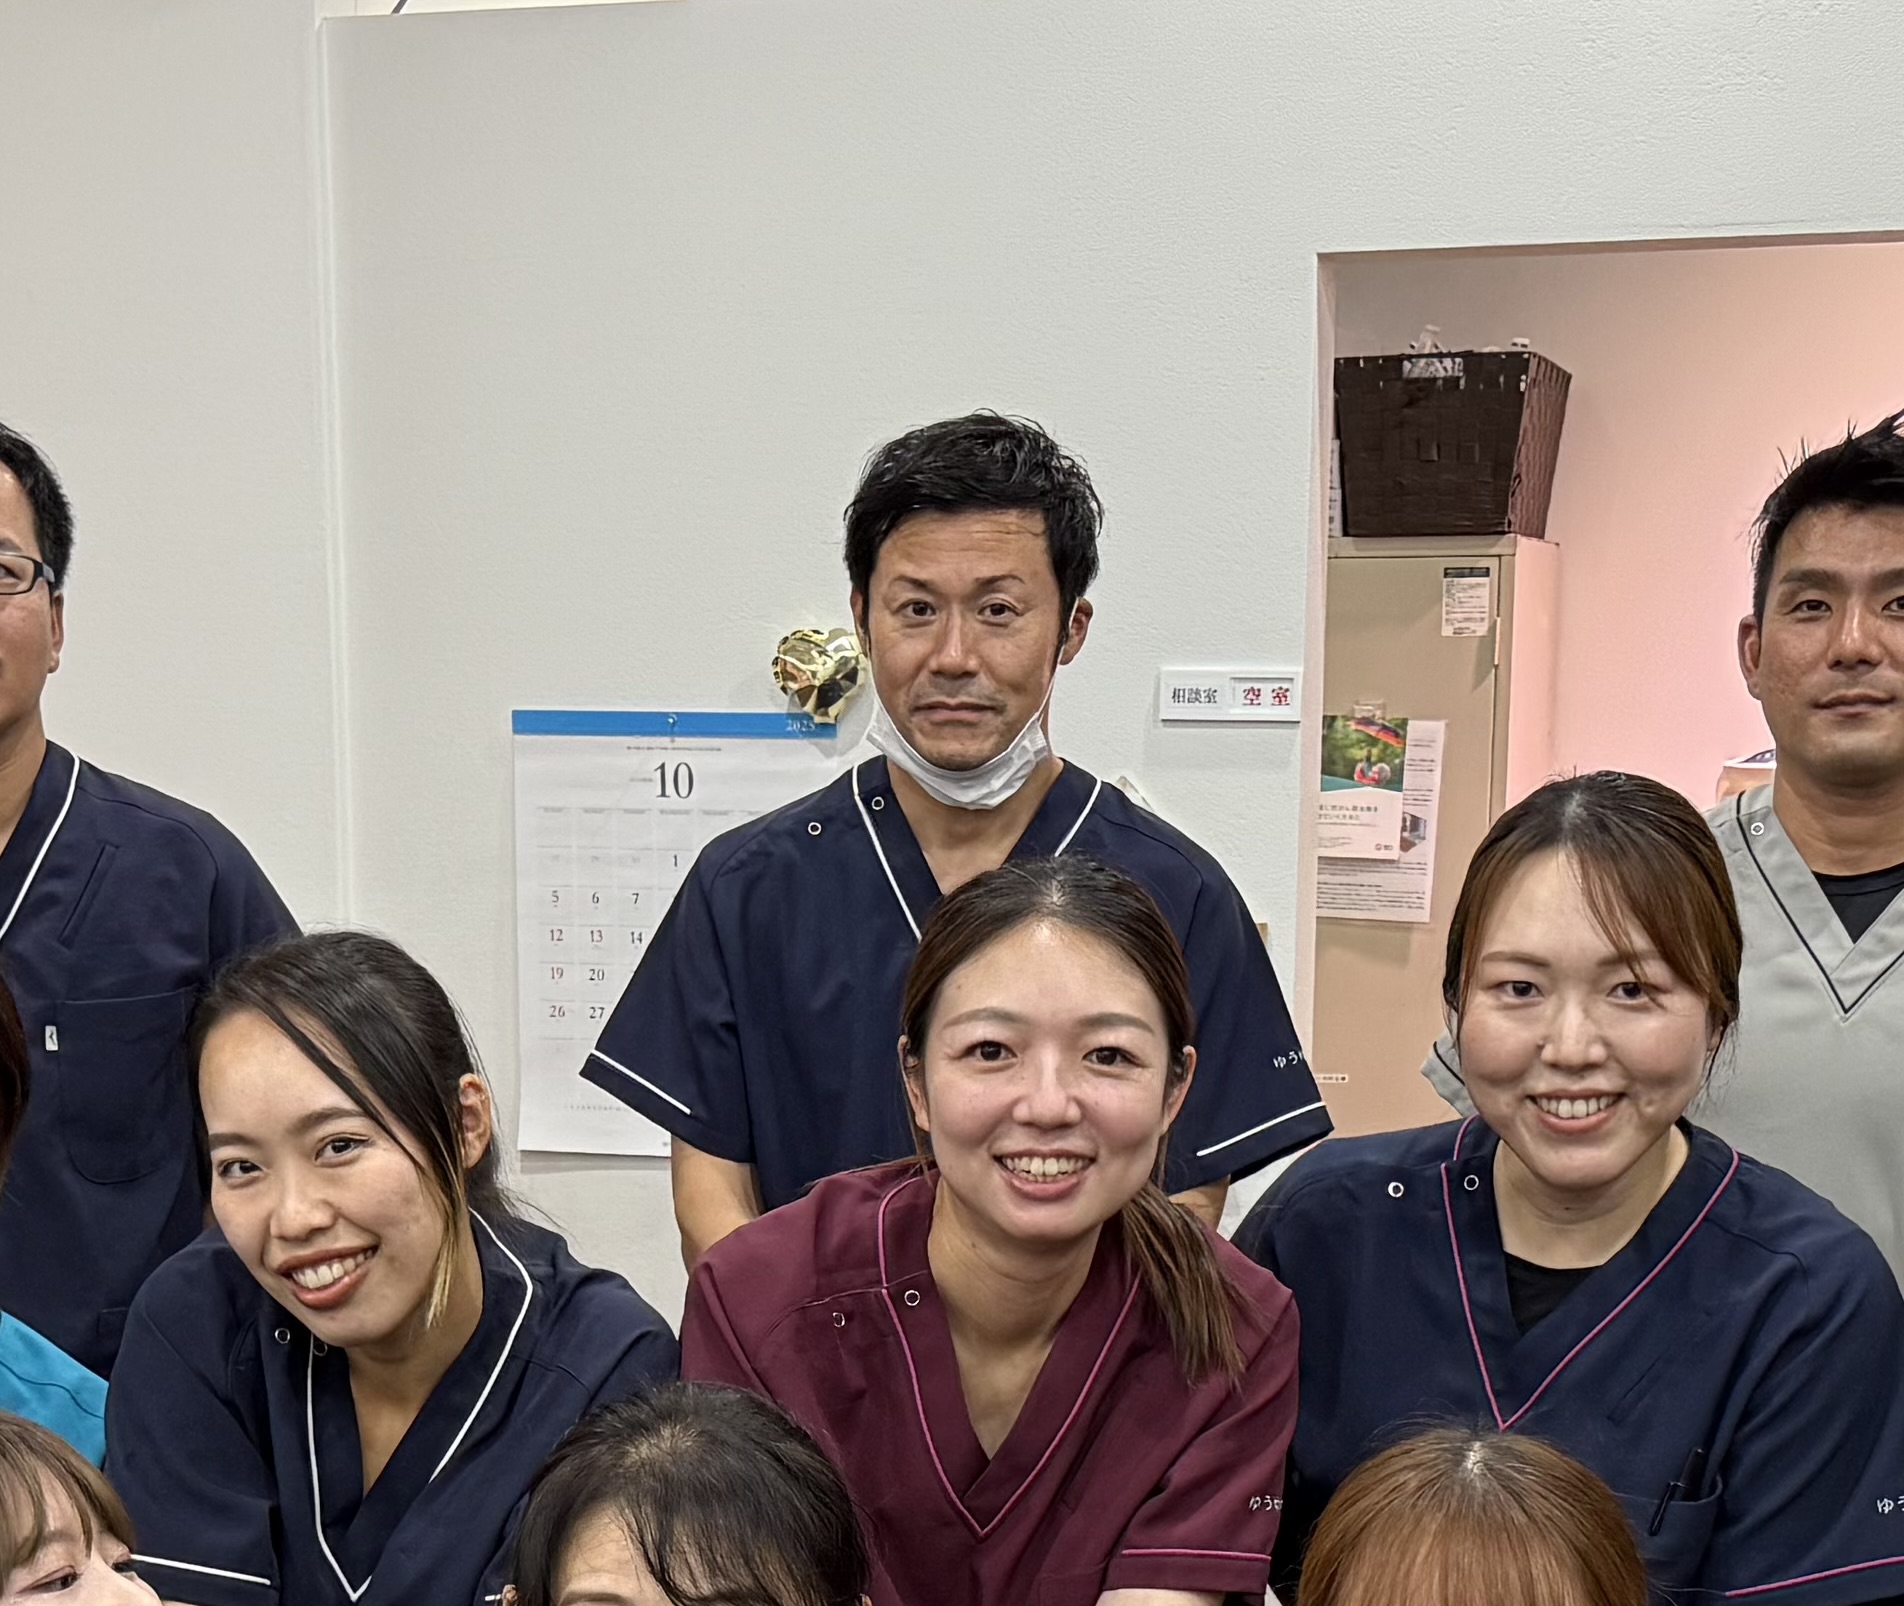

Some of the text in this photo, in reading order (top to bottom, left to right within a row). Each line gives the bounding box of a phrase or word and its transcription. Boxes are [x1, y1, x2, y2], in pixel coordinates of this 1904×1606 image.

[1172, 687, 1218, 704] 相談室
[1242, 686, 1290, 706] 空室
[785, 720, 815, 732] 2025
[653, 761, 694, 799] 10
[673, 854, 678, 867] 1
[551, 890, 640, 905] 5 6 7
[550, 929, 643, 945] 12 13 14
[551, 967, 605, 981] 19 20
[549, 1005, 605, 1019] 26 27
[1273, 1051, 1302, 1068] ゆう
